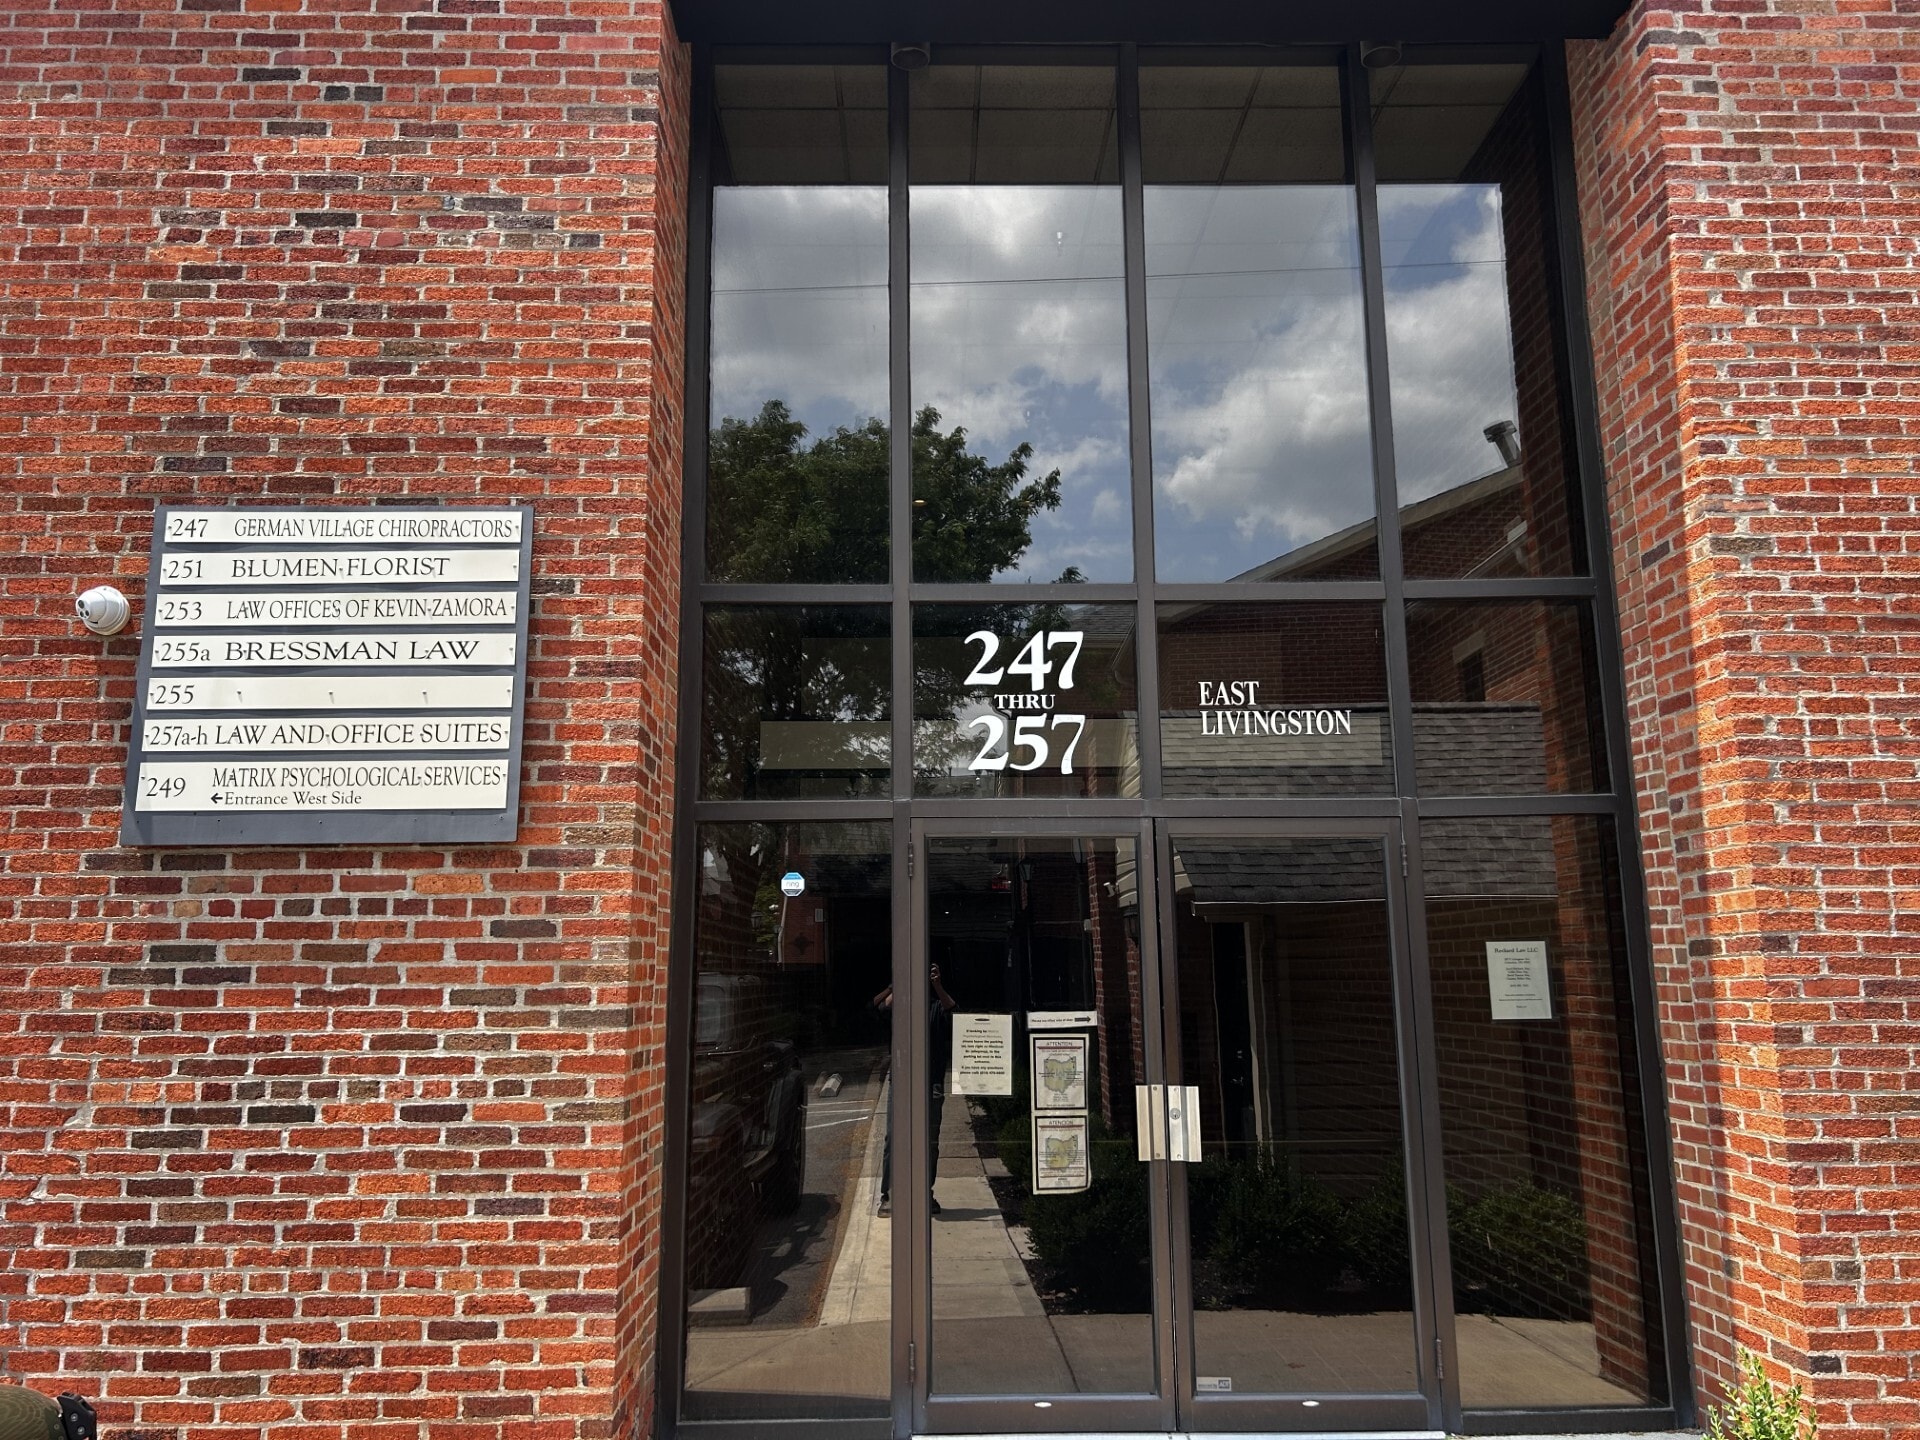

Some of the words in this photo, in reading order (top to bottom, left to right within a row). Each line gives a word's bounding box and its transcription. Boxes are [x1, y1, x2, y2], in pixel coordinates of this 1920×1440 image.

[171, 518, 208, 538] 247
[234, 518, 305, 538] GERMAN
[309, 519, 374, 537] VILLAGE
[378, 519, 512, 538] CHIROPRACTORS
[167, 560, 202, 579] 251
[231, 558, 339, 578] BLUMEN
[346, 557, 451, 576] FLORIST
[163, 601, 202, 620] 253
[226, 600, 266, 619] LAW
[269, 599, 341, 619] OFFICES
[345, 599, 370, 618] OF
[373, 598, 427, 618] KEVIN
[432, 597, 507, 617] ZAMORA
[160, 642, 211, 662] 255a
[224, 641, 398, 661] BRESSMAN
[408, 640, 480, 660] LAW
[963, 630, 1084, 691] 247
[155, 685, 195, 705] 255
[994, 694, 1055, 709] THRU
[1199, 681, 1259, 706] EAST
[1200, 709, 1351, 735] LIVINGSTON
[149, 725, 208, 747] 257a-h
[215, 725, 267, 745] LAW
[271, 724, 325, 744] AND
[331, 724, 415, 744] OFFICE
[420, 723, 502, 743] SUITES
[967, 713, 1086, 775] 257
[145, 777, 186, 798] 249
[212, 767, 277, 788] MATRIX
[280, 766, 418, 787] PSYCHOLOGICAL
[424, 766, 501, 786] SERVICES
[225, 791, 288, 805] Entrance
[292, 791, 327, 805] West
[331, 791, 362, 805] Side
[786, 881, 800, 889] ring
